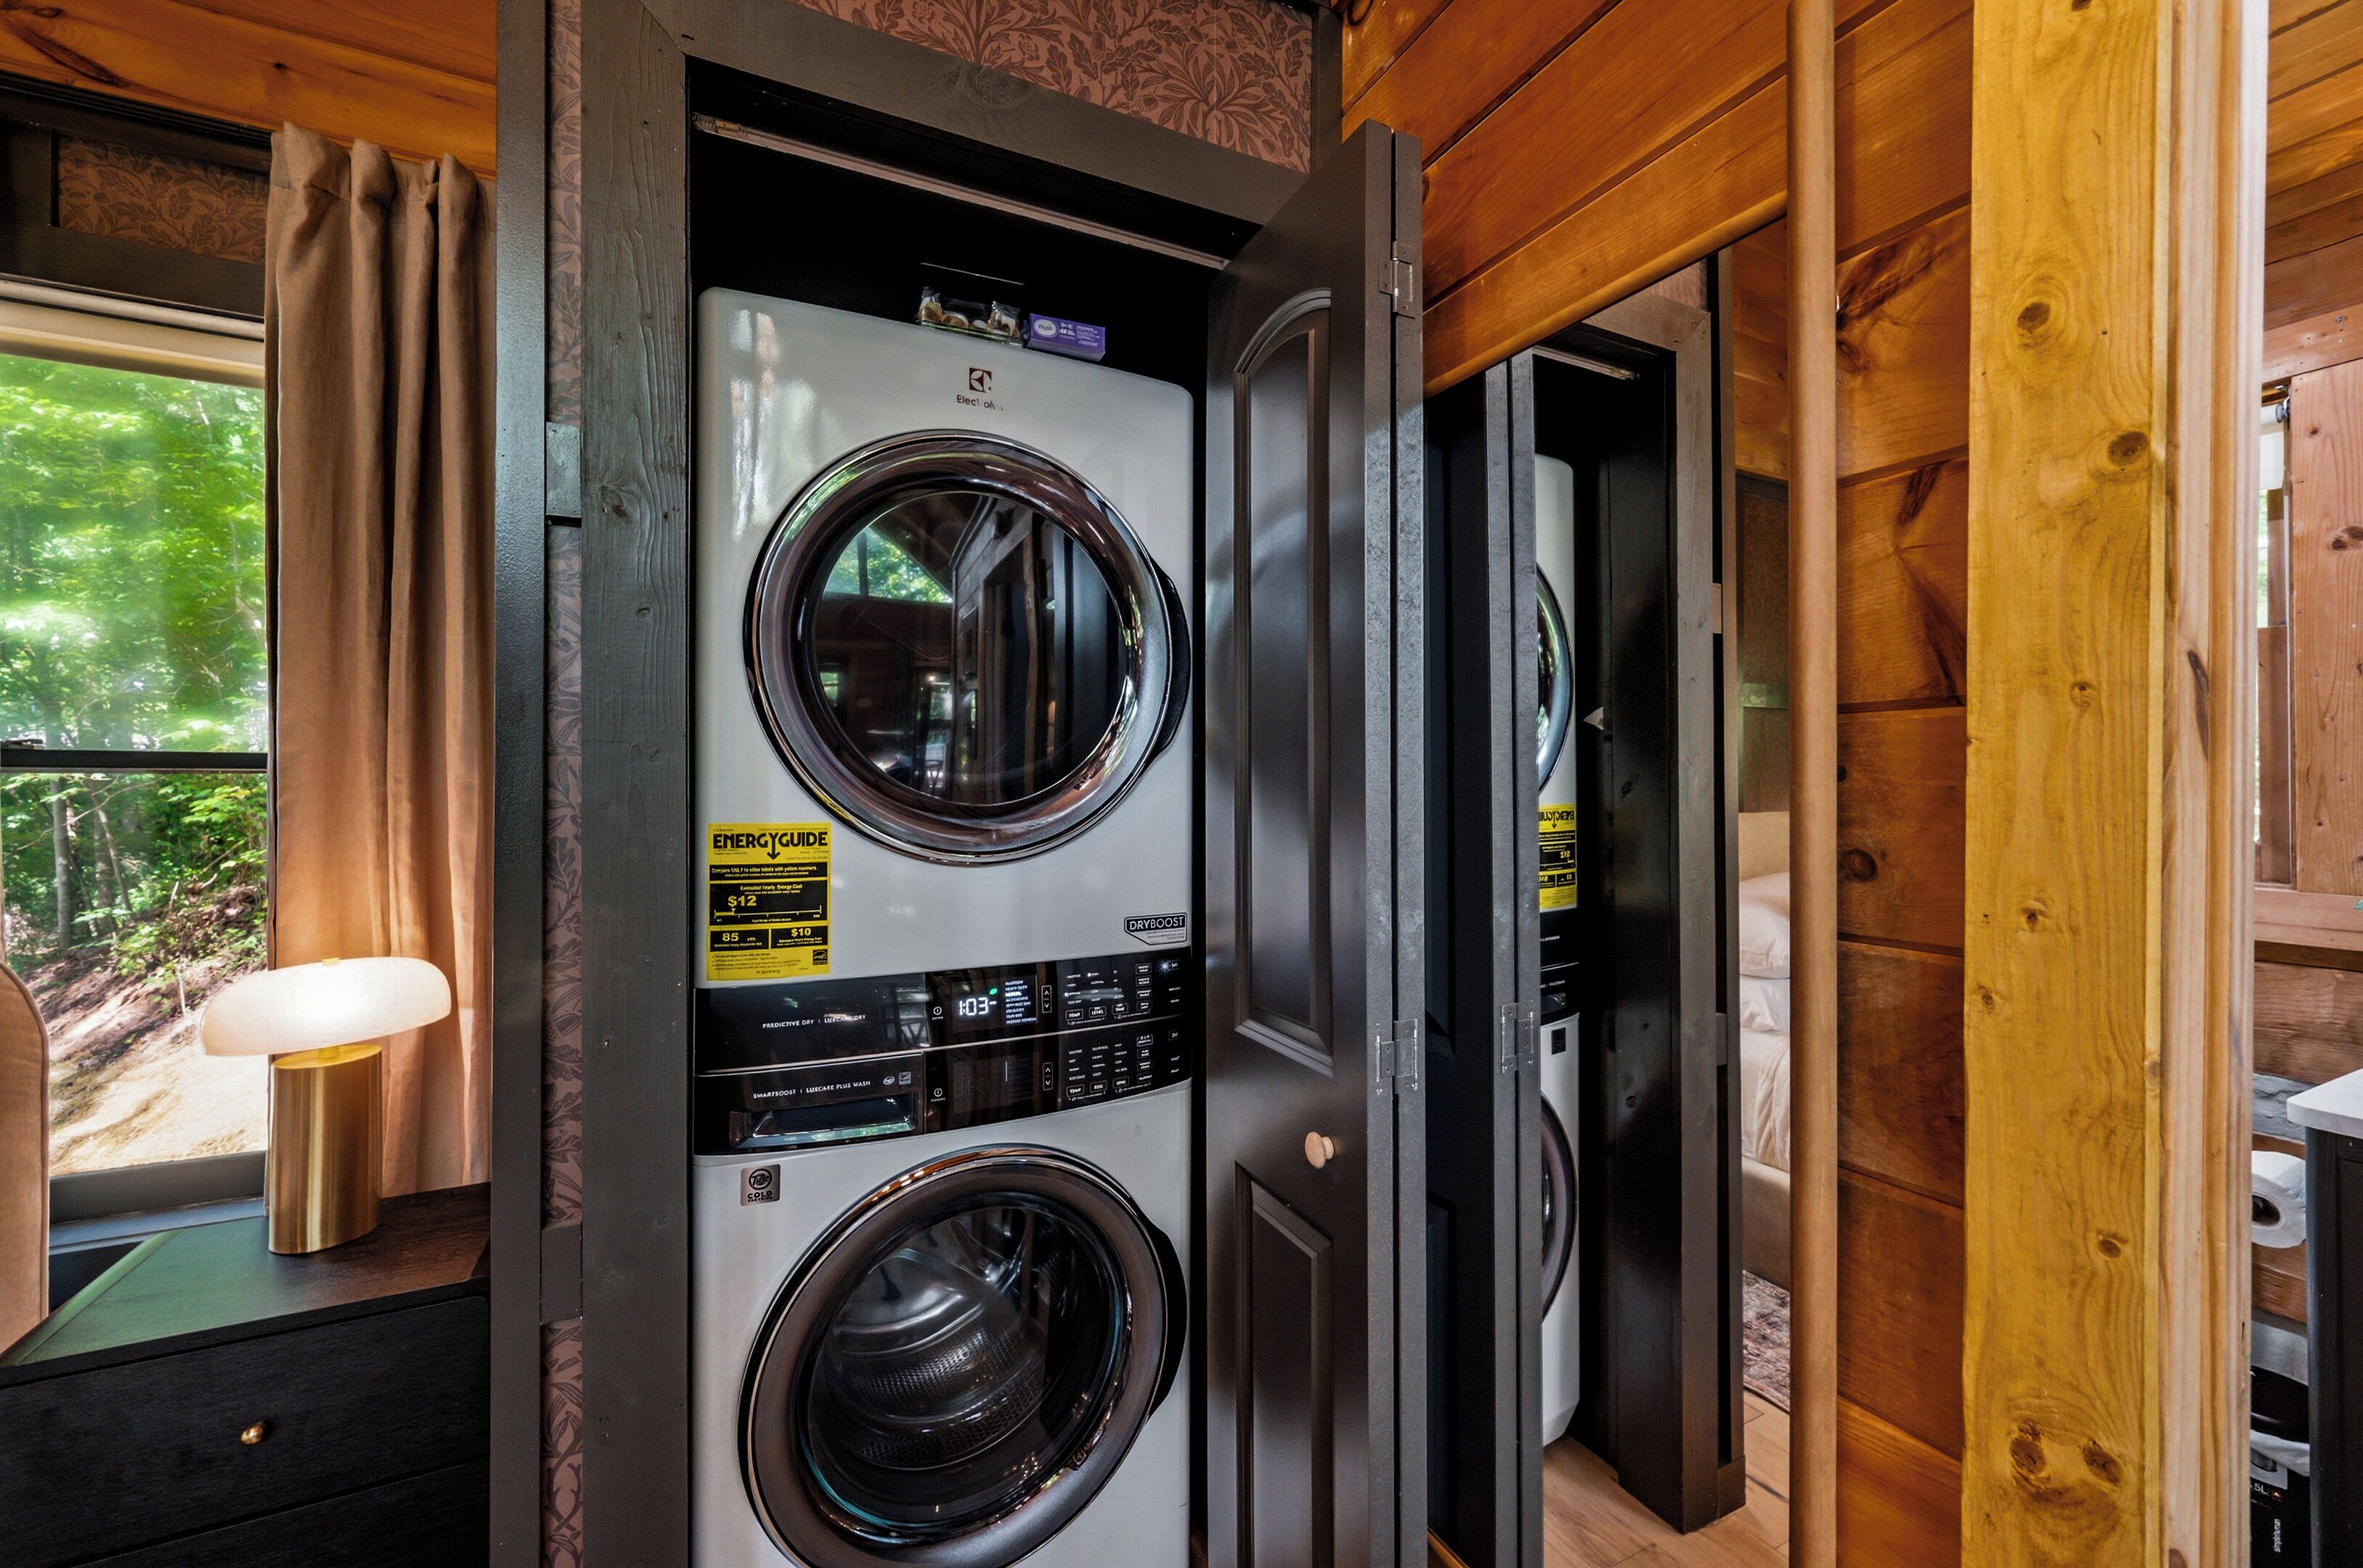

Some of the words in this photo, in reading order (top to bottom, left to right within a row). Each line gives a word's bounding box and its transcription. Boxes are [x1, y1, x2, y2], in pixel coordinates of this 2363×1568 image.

[957, 394, 1003, 412] Elecol
[713, 831, 828, 849] ENERGYGUIDE
[727, 894, 757, 907] $12
[1130, 917, 1183, 930] DRYBOOST
[722, 933, 739, 942] 85
[791, 927, 812, 937] $10
[959, 997, 989, 1016] 1:03
[753, 1089, 796, 1099] SMARTBOOST
[806, 1085, 835, 1093] LUXCARE
[747, 1191, 772, 1199] COLD
[2250, 1482, 2268, 1495] 5L
